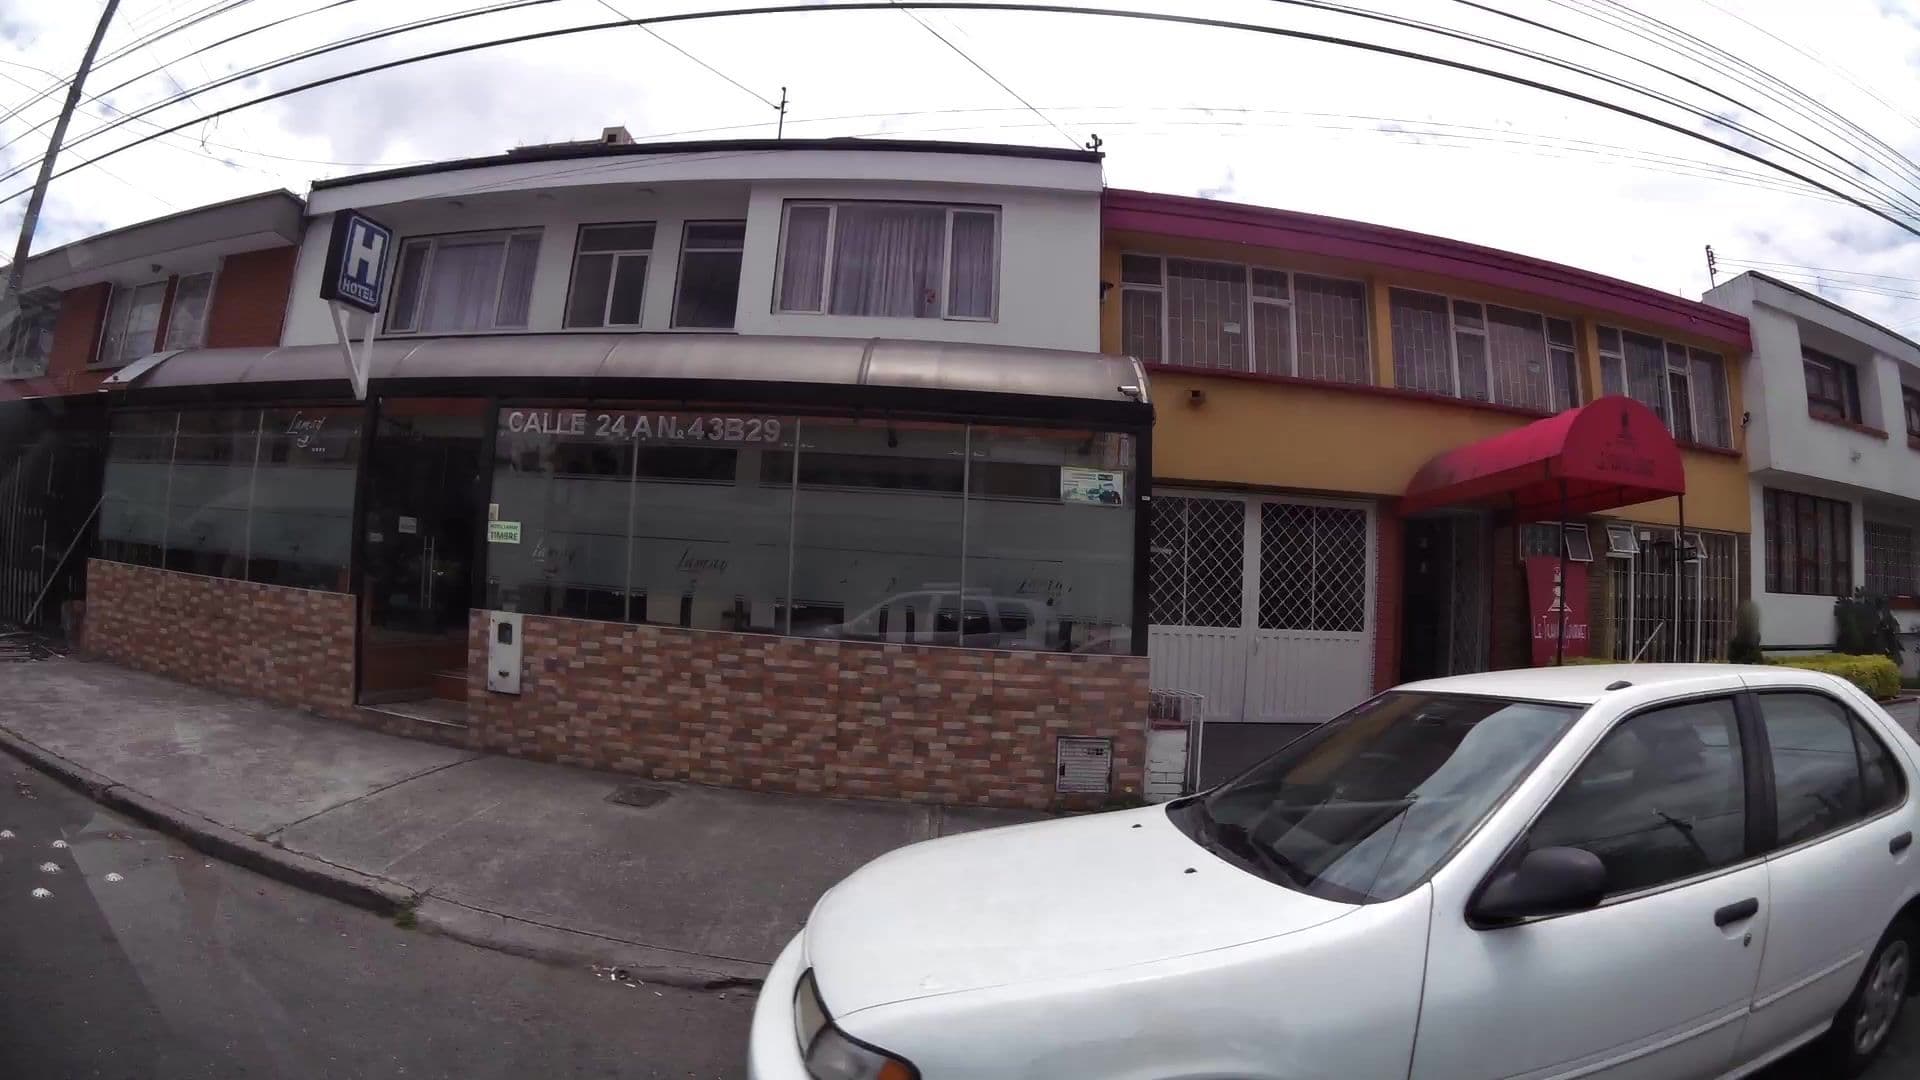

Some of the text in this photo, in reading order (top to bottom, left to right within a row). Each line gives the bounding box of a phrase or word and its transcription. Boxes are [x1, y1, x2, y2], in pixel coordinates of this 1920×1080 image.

[347, 224, 384, 287] H
[342, 278, 375, 301] HOTEL
[508, 411, 587, 435] CALLE
[596, 414, 626, 437] 24
[687, 416, 781, 442] 43B29
[490, 531, 519, 541] TIMBRE
